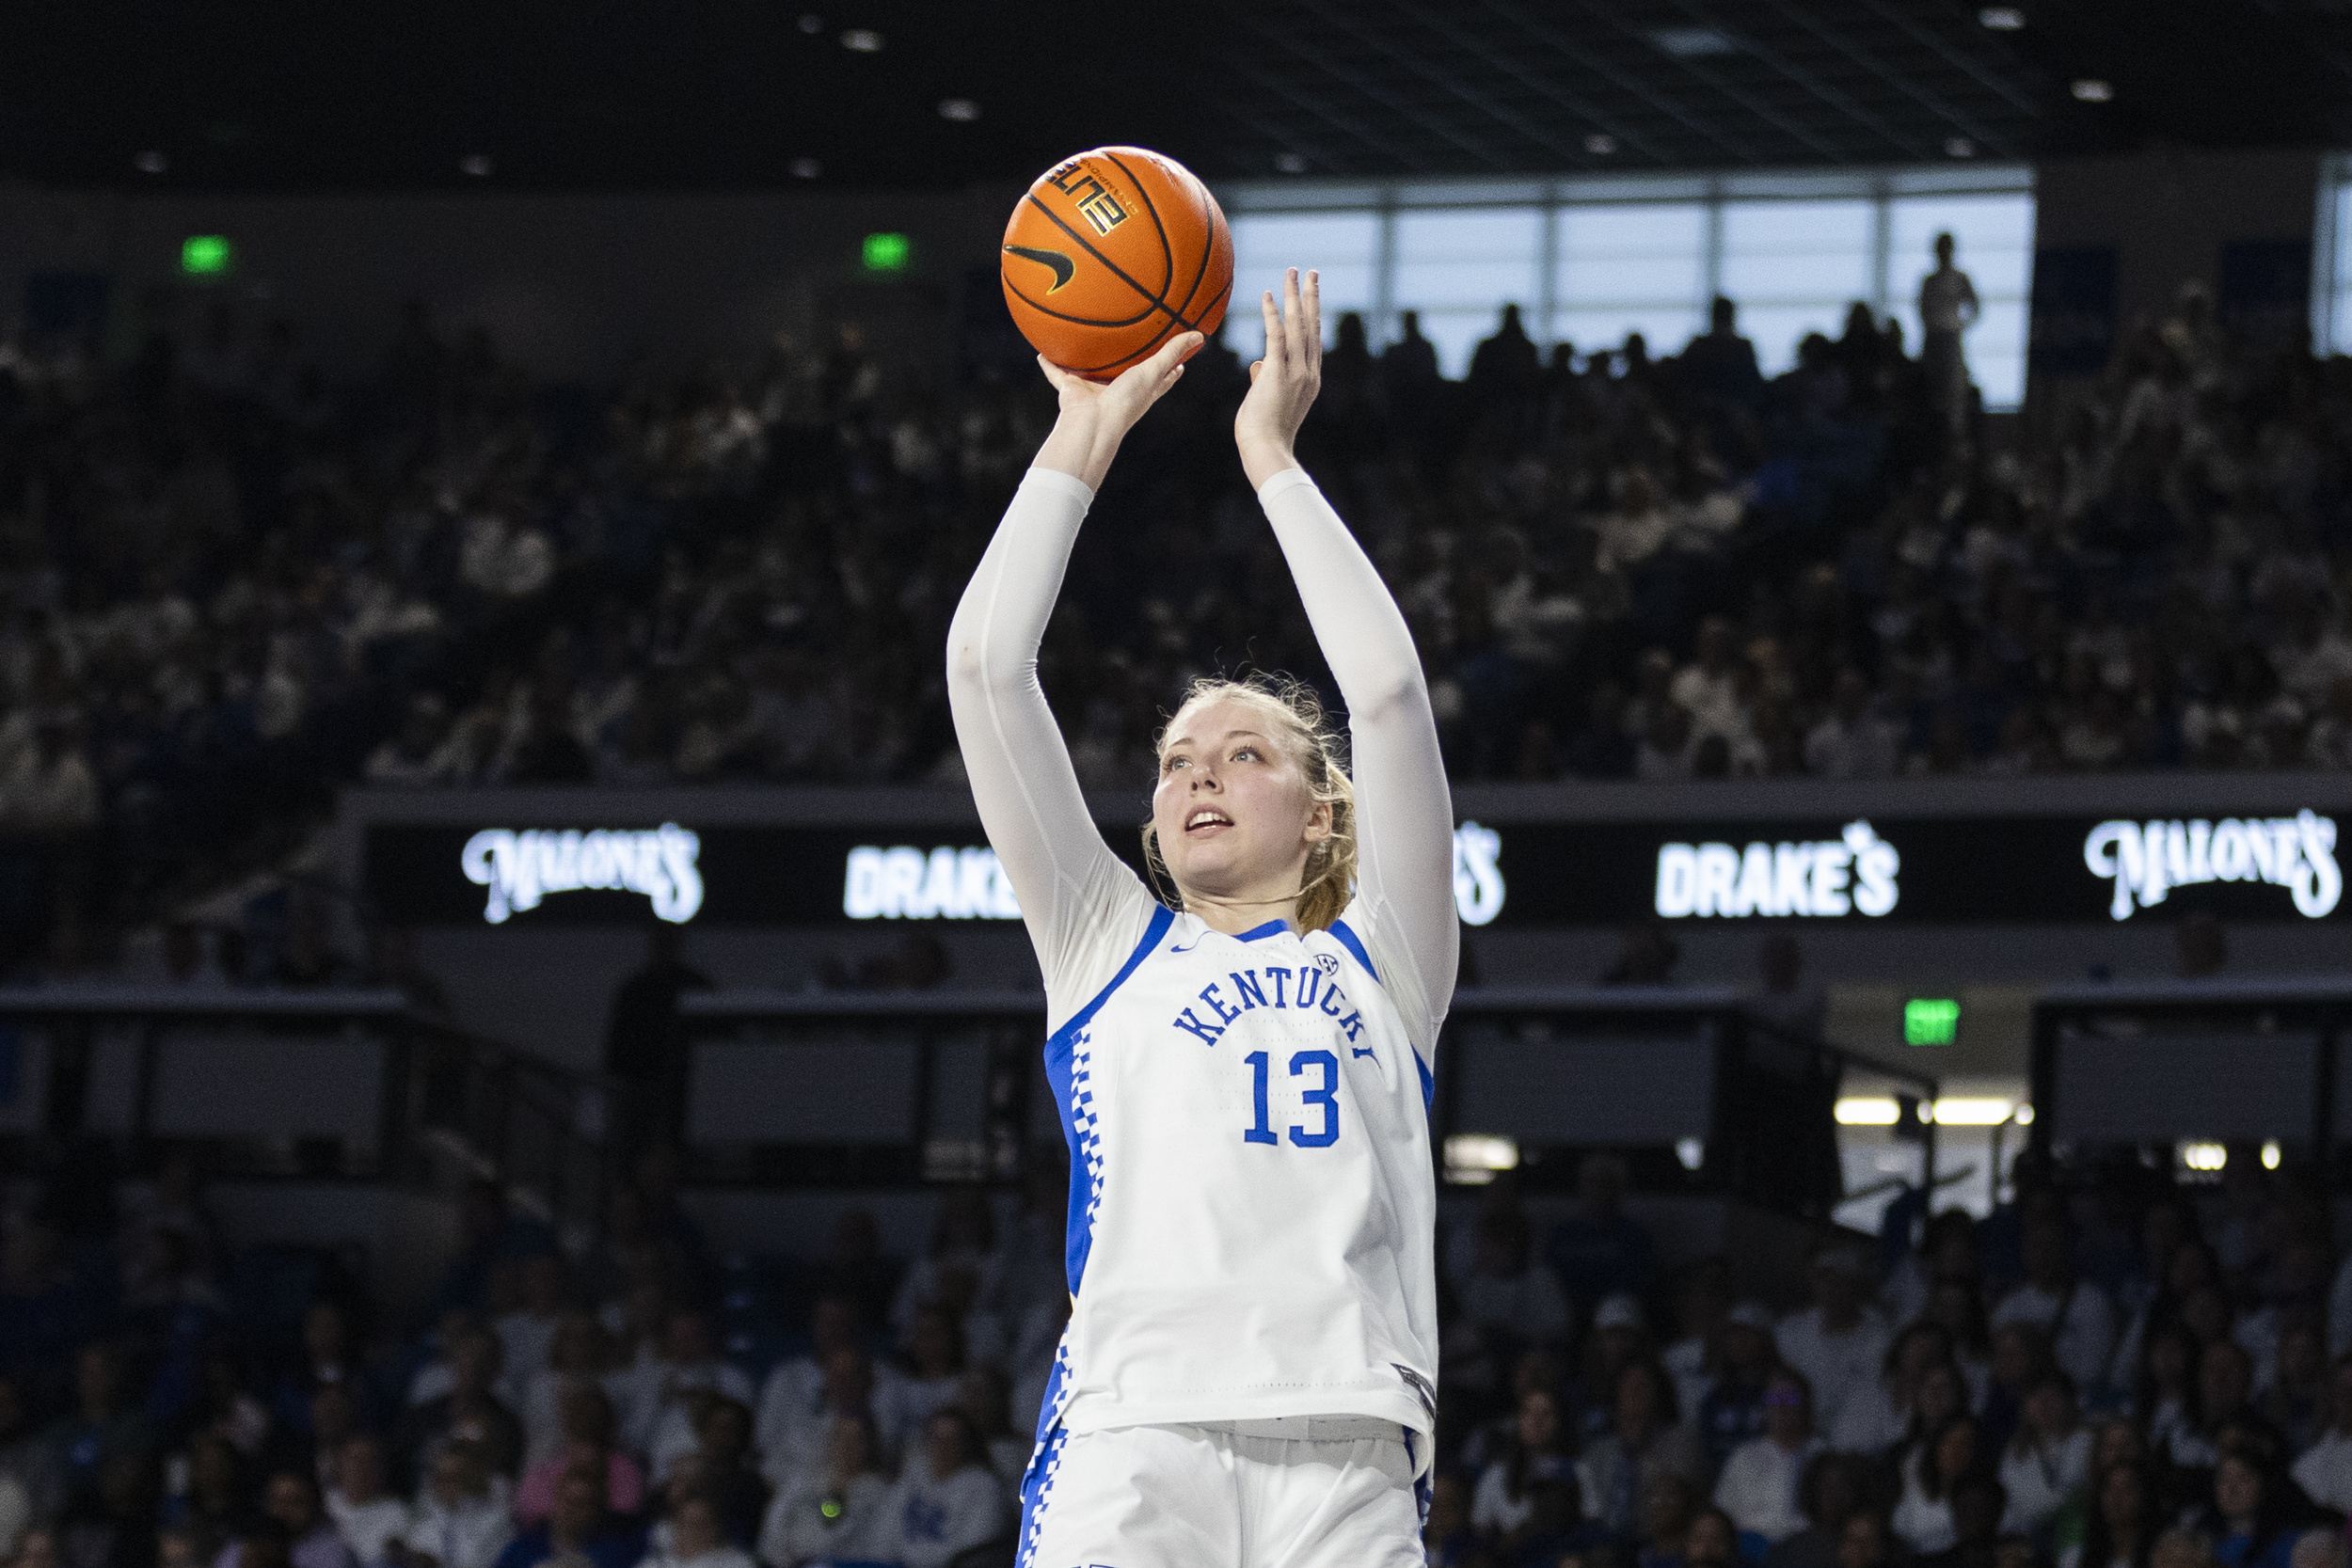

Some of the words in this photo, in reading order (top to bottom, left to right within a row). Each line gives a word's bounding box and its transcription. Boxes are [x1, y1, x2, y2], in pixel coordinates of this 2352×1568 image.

[845, 847, 1024, 919] DRAKE
[1655, 820, 1899, 918] DRAKE'S
[1244, 1050, 1340, 1148] 13
